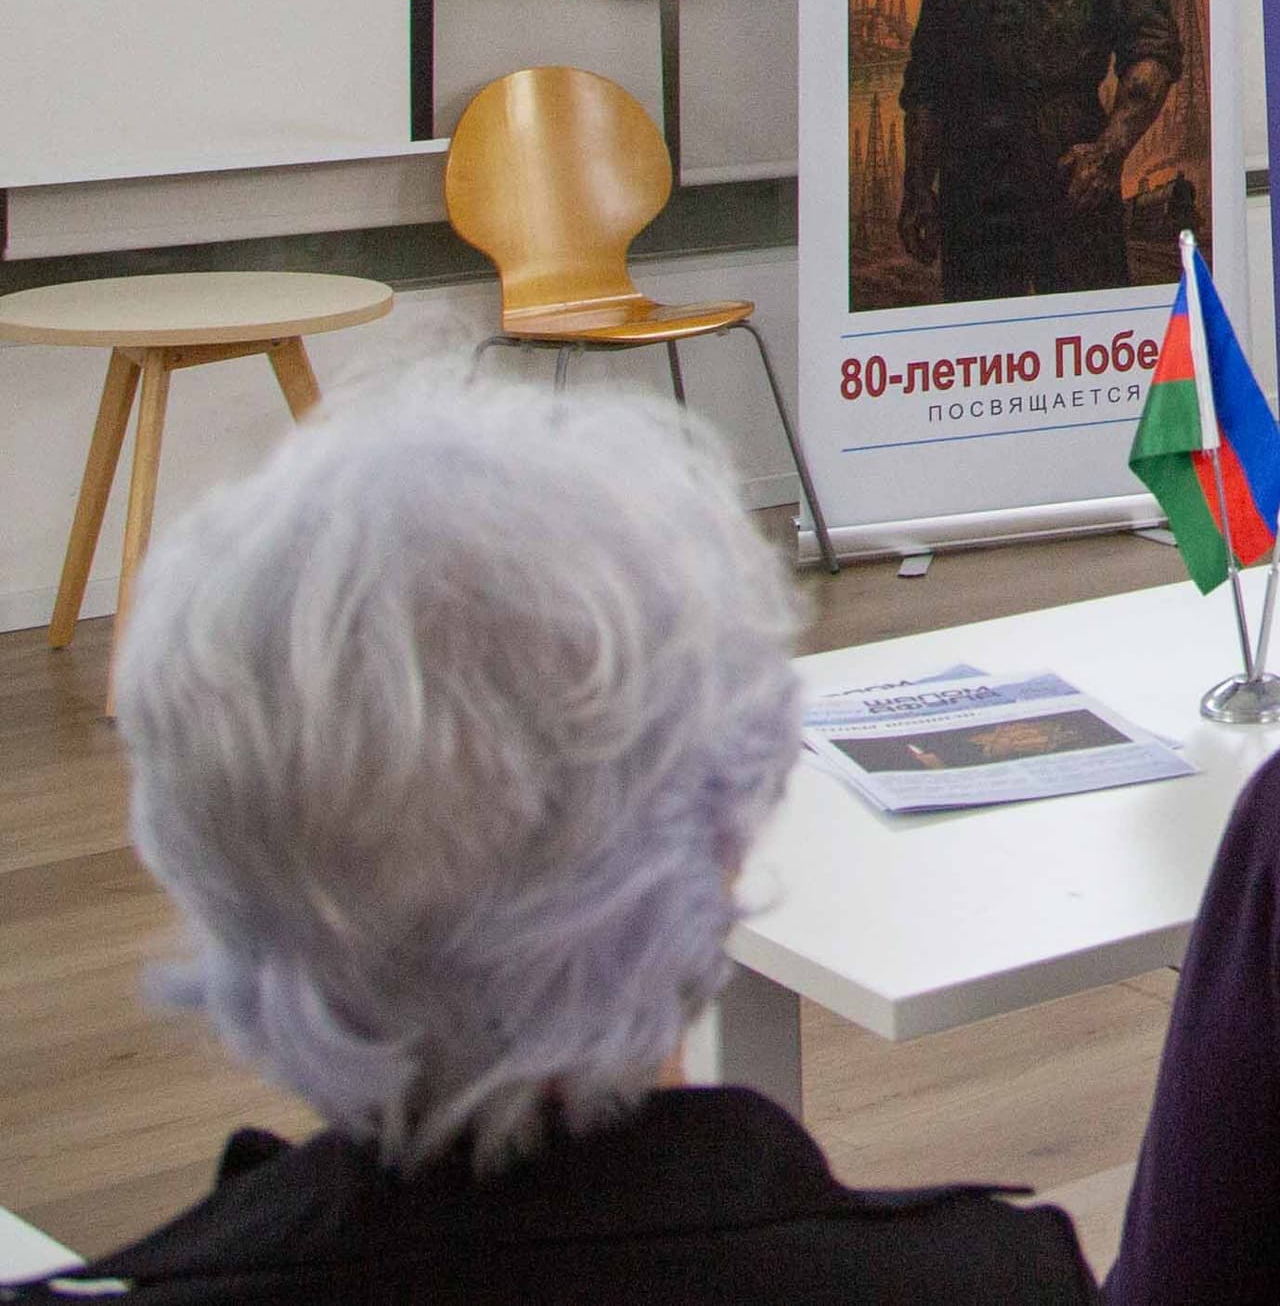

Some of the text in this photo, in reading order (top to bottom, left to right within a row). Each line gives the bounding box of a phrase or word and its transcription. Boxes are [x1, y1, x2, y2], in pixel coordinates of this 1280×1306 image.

[840, 329, 1158, 401] 80-летию Побе
[928, 384, 1142, 422] ПОСВЯЩАЕТСЯ
